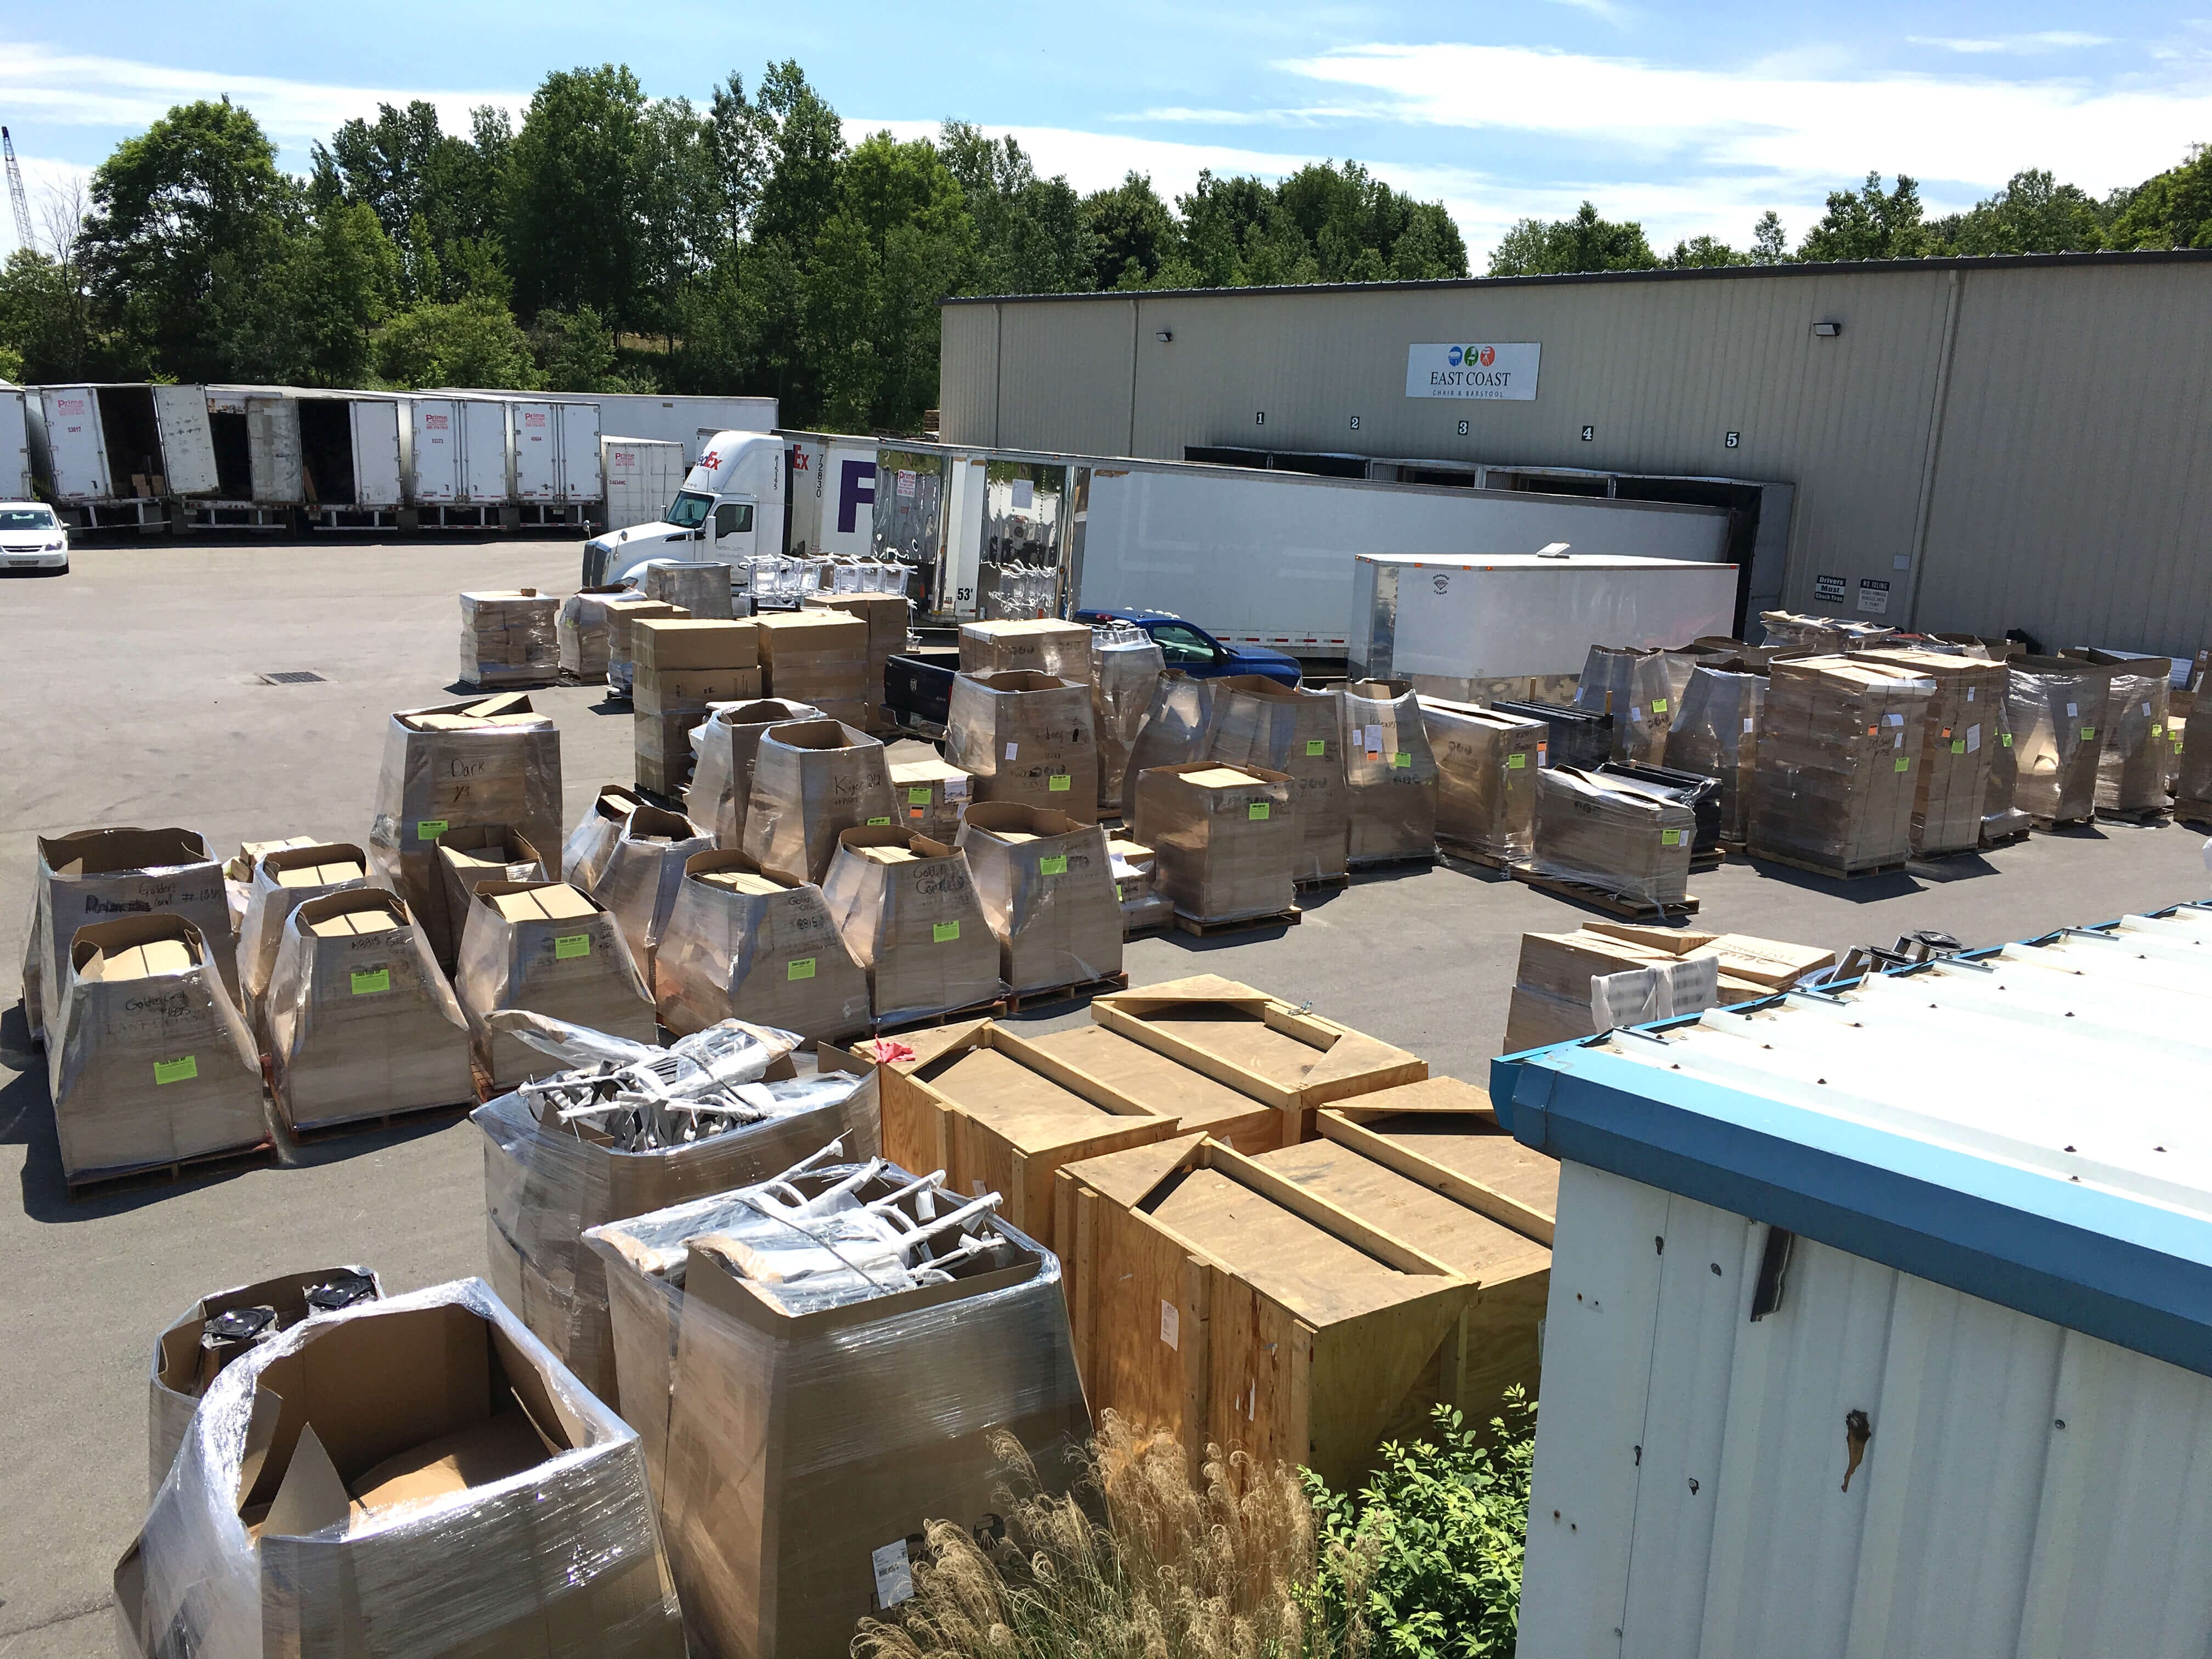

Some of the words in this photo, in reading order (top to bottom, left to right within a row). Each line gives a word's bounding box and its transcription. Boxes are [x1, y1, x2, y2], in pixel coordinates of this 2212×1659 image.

[1430, 371, 1463, 385] EAST
[1466, 372, 1511, 386] COAST
[1257, 413, 1263, 424] 1
[1351, 417, 1359, 429] 2
[1459, 422, 1468, 434] 3
[1583, 427, 1593, 440] 4
[1726, 433, 1738, 447] 5
[899, 471, 915, 482] Prime
[1819, 577, 1844, 585] Drivers
[957, 588, 973, 601] 53'
[1821, 585, 1839, 593] Must
[452, 759, 484, 777] Dark
